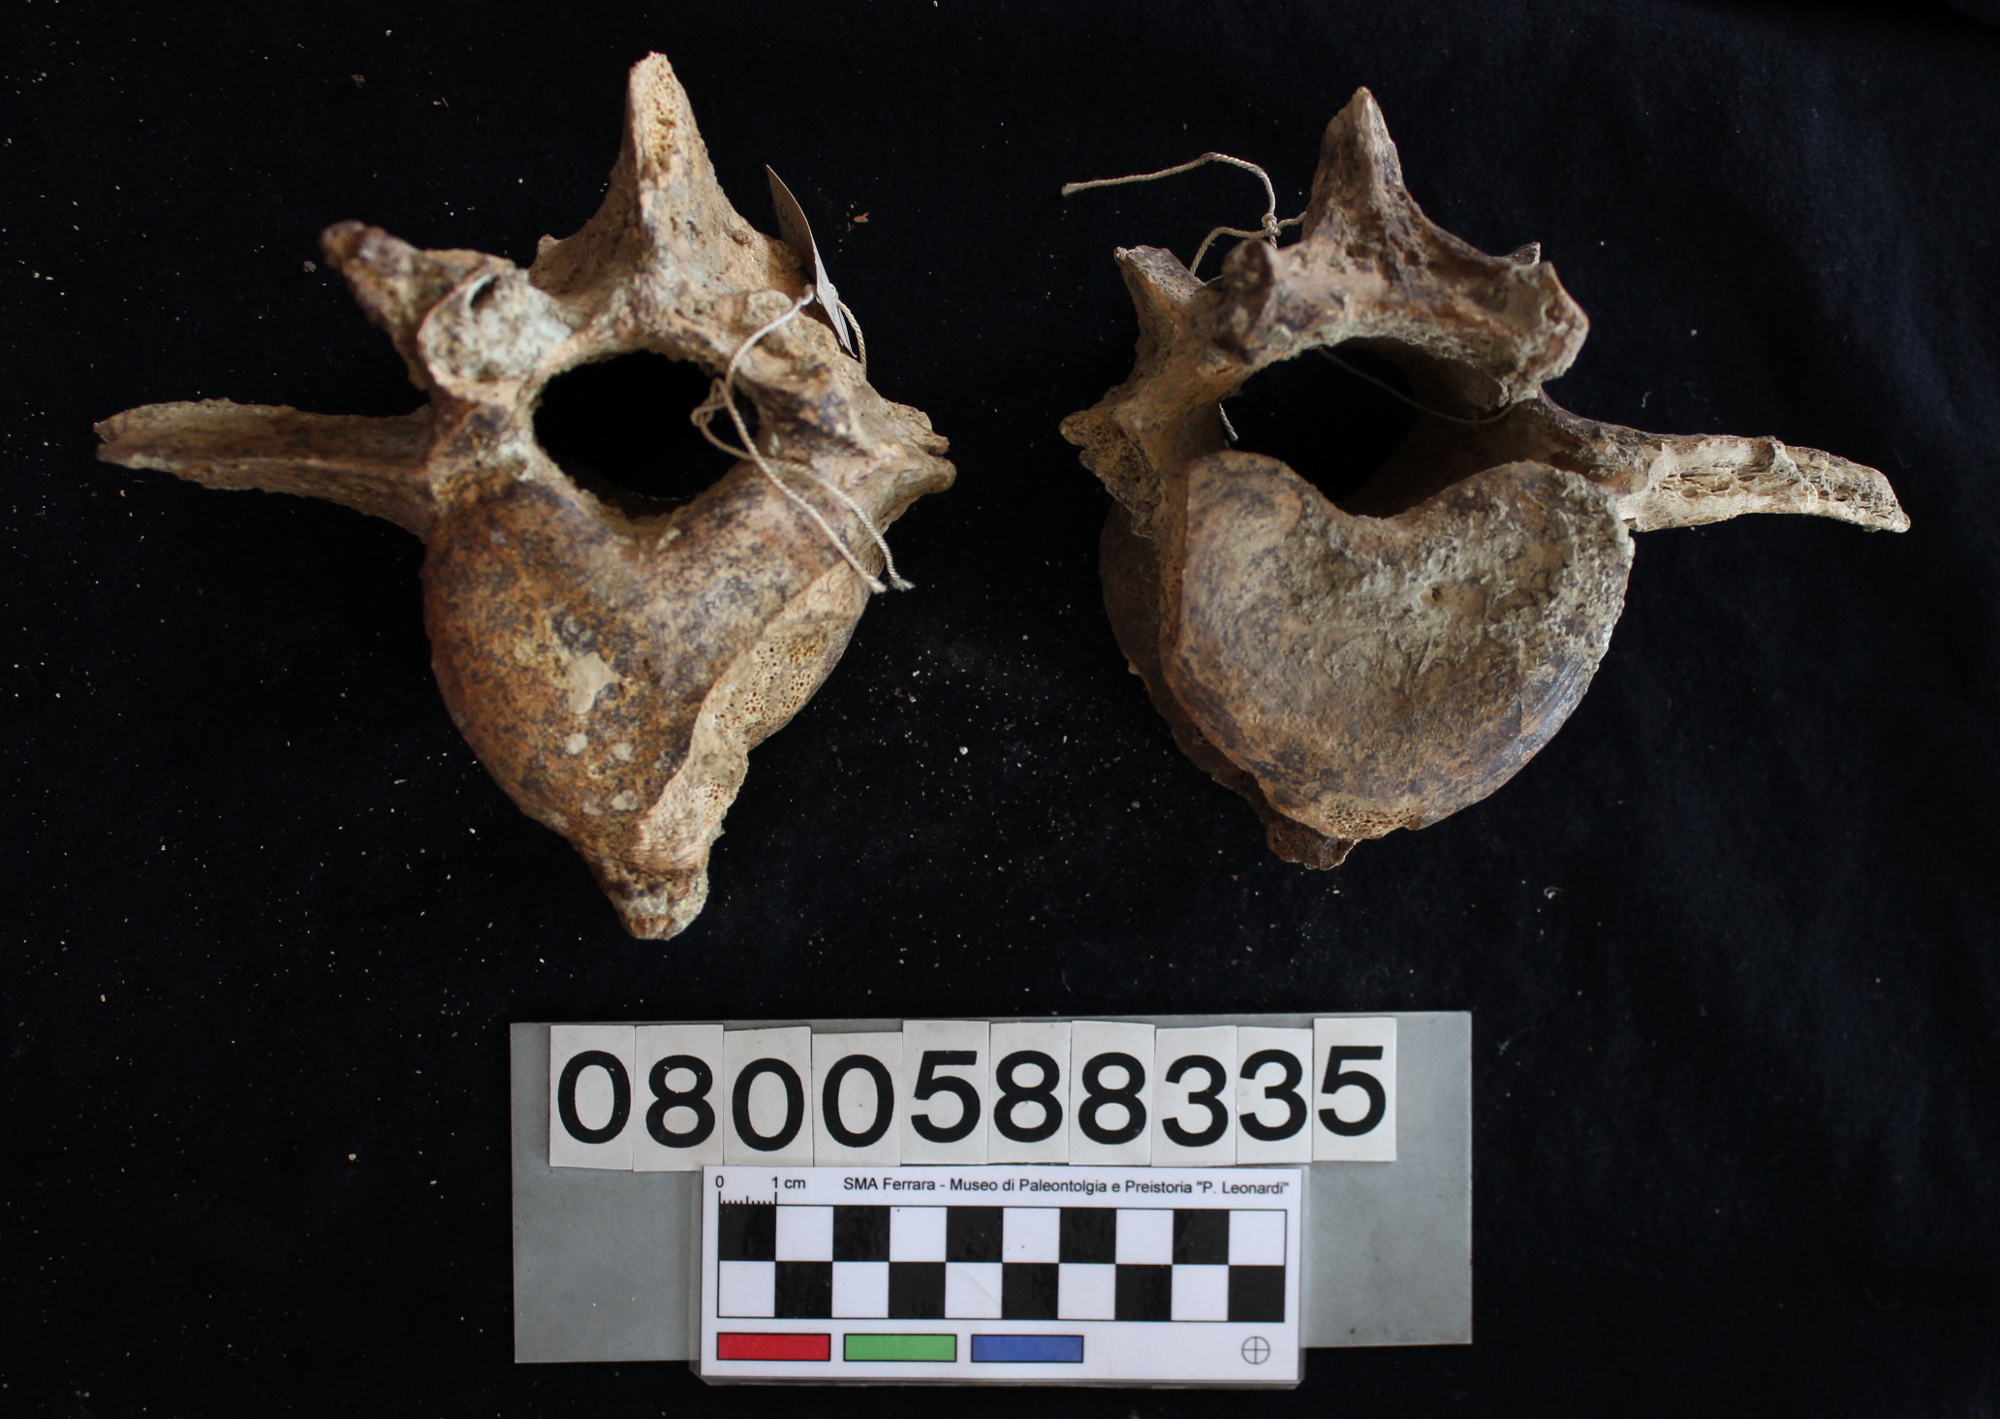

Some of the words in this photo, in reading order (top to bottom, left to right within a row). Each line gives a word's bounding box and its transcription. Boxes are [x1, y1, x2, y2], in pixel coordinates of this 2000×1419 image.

[557, 1045, 1387, 1152] 0800588335
[714, 1174, 725, 1189] 0
[771, 1175, 779, 1189] 1
[783, 1178, 806, 1190] cm
[843, 1176, 879, 1191] SMA
[882, 1177, 936, 1191] Ferrara
[949, 1177, 999, 1192] Museo
[1001, 1178, 1015, 1192] di
[1018, 1178, 1107, 1196] Paleontolgia
[1111, 1182, 1121, 1193] e
[1125, 1179, 1193, 1194] Preistoria
[1196, 1180, 1217, 1194] "P.
[1222, 1181, 1290, 1195] Leonardi"
